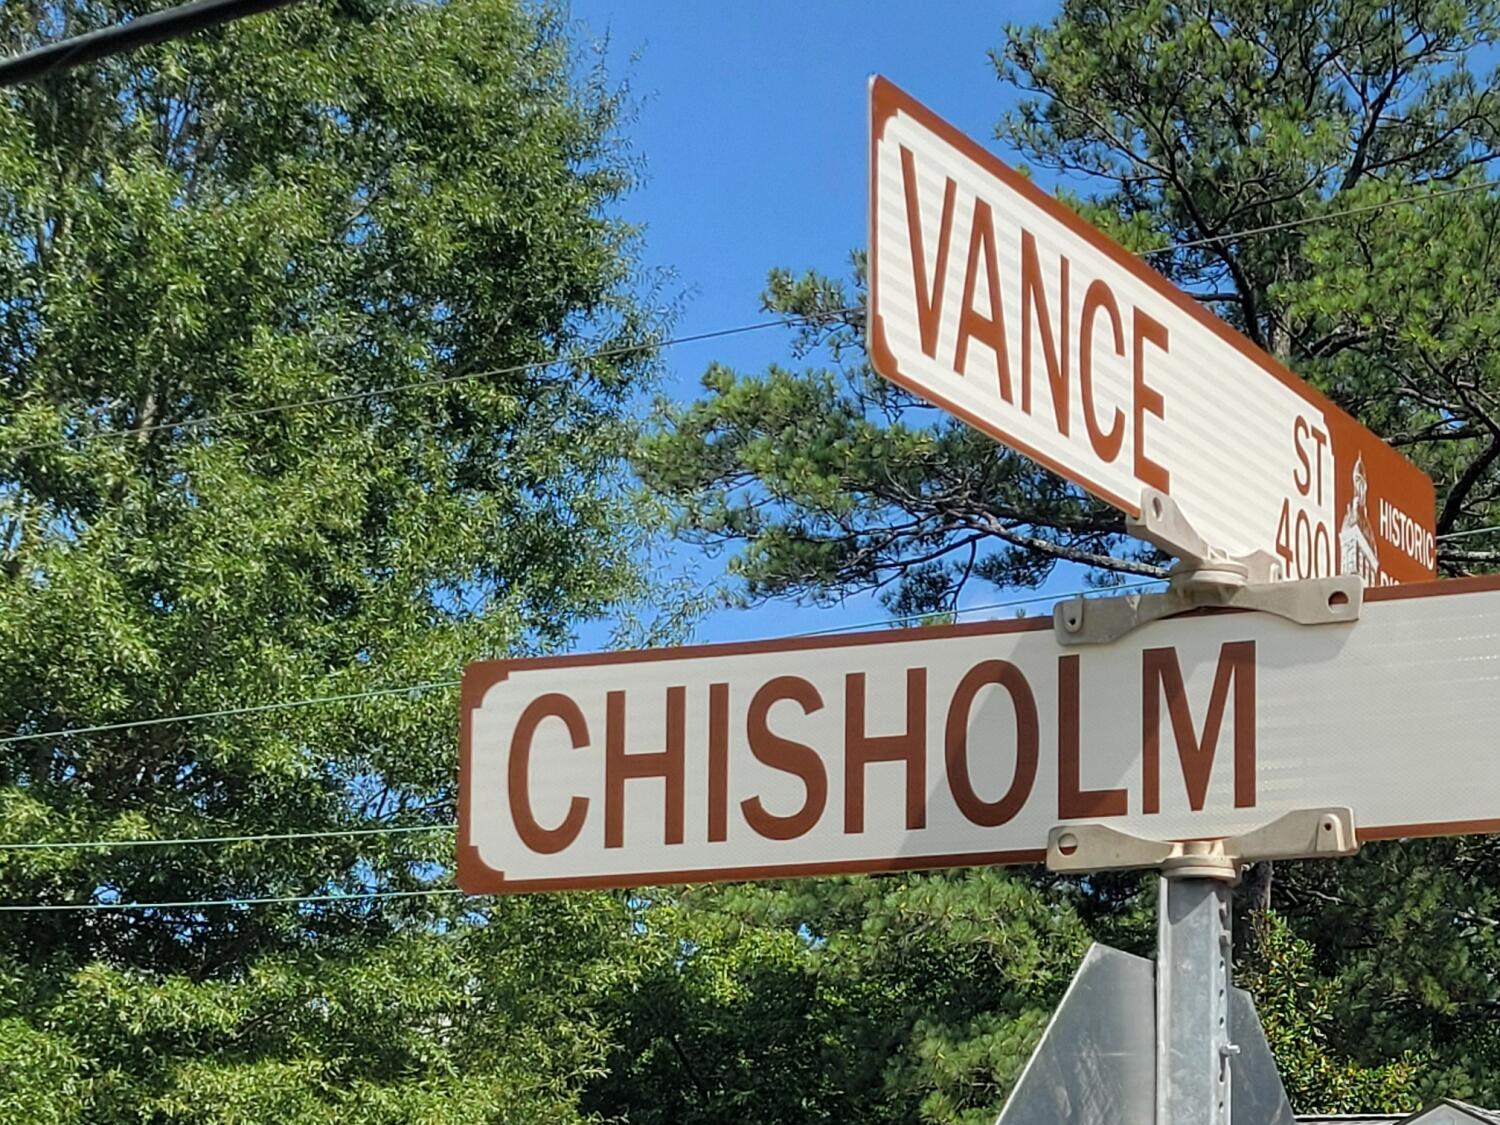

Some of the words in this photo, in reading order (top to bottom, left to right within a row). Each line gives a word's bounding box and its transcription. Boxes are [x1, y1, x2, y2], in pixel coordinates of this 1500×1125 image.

[899, 144, 1171, 495] VANCE
[1293, 415, 1327, 507] ST
[1276, 498, 1331, 579] 400
[1380, 498, 1434, 571] HISTORIC
[508, 640, 1256, 854] CHISHOLM
